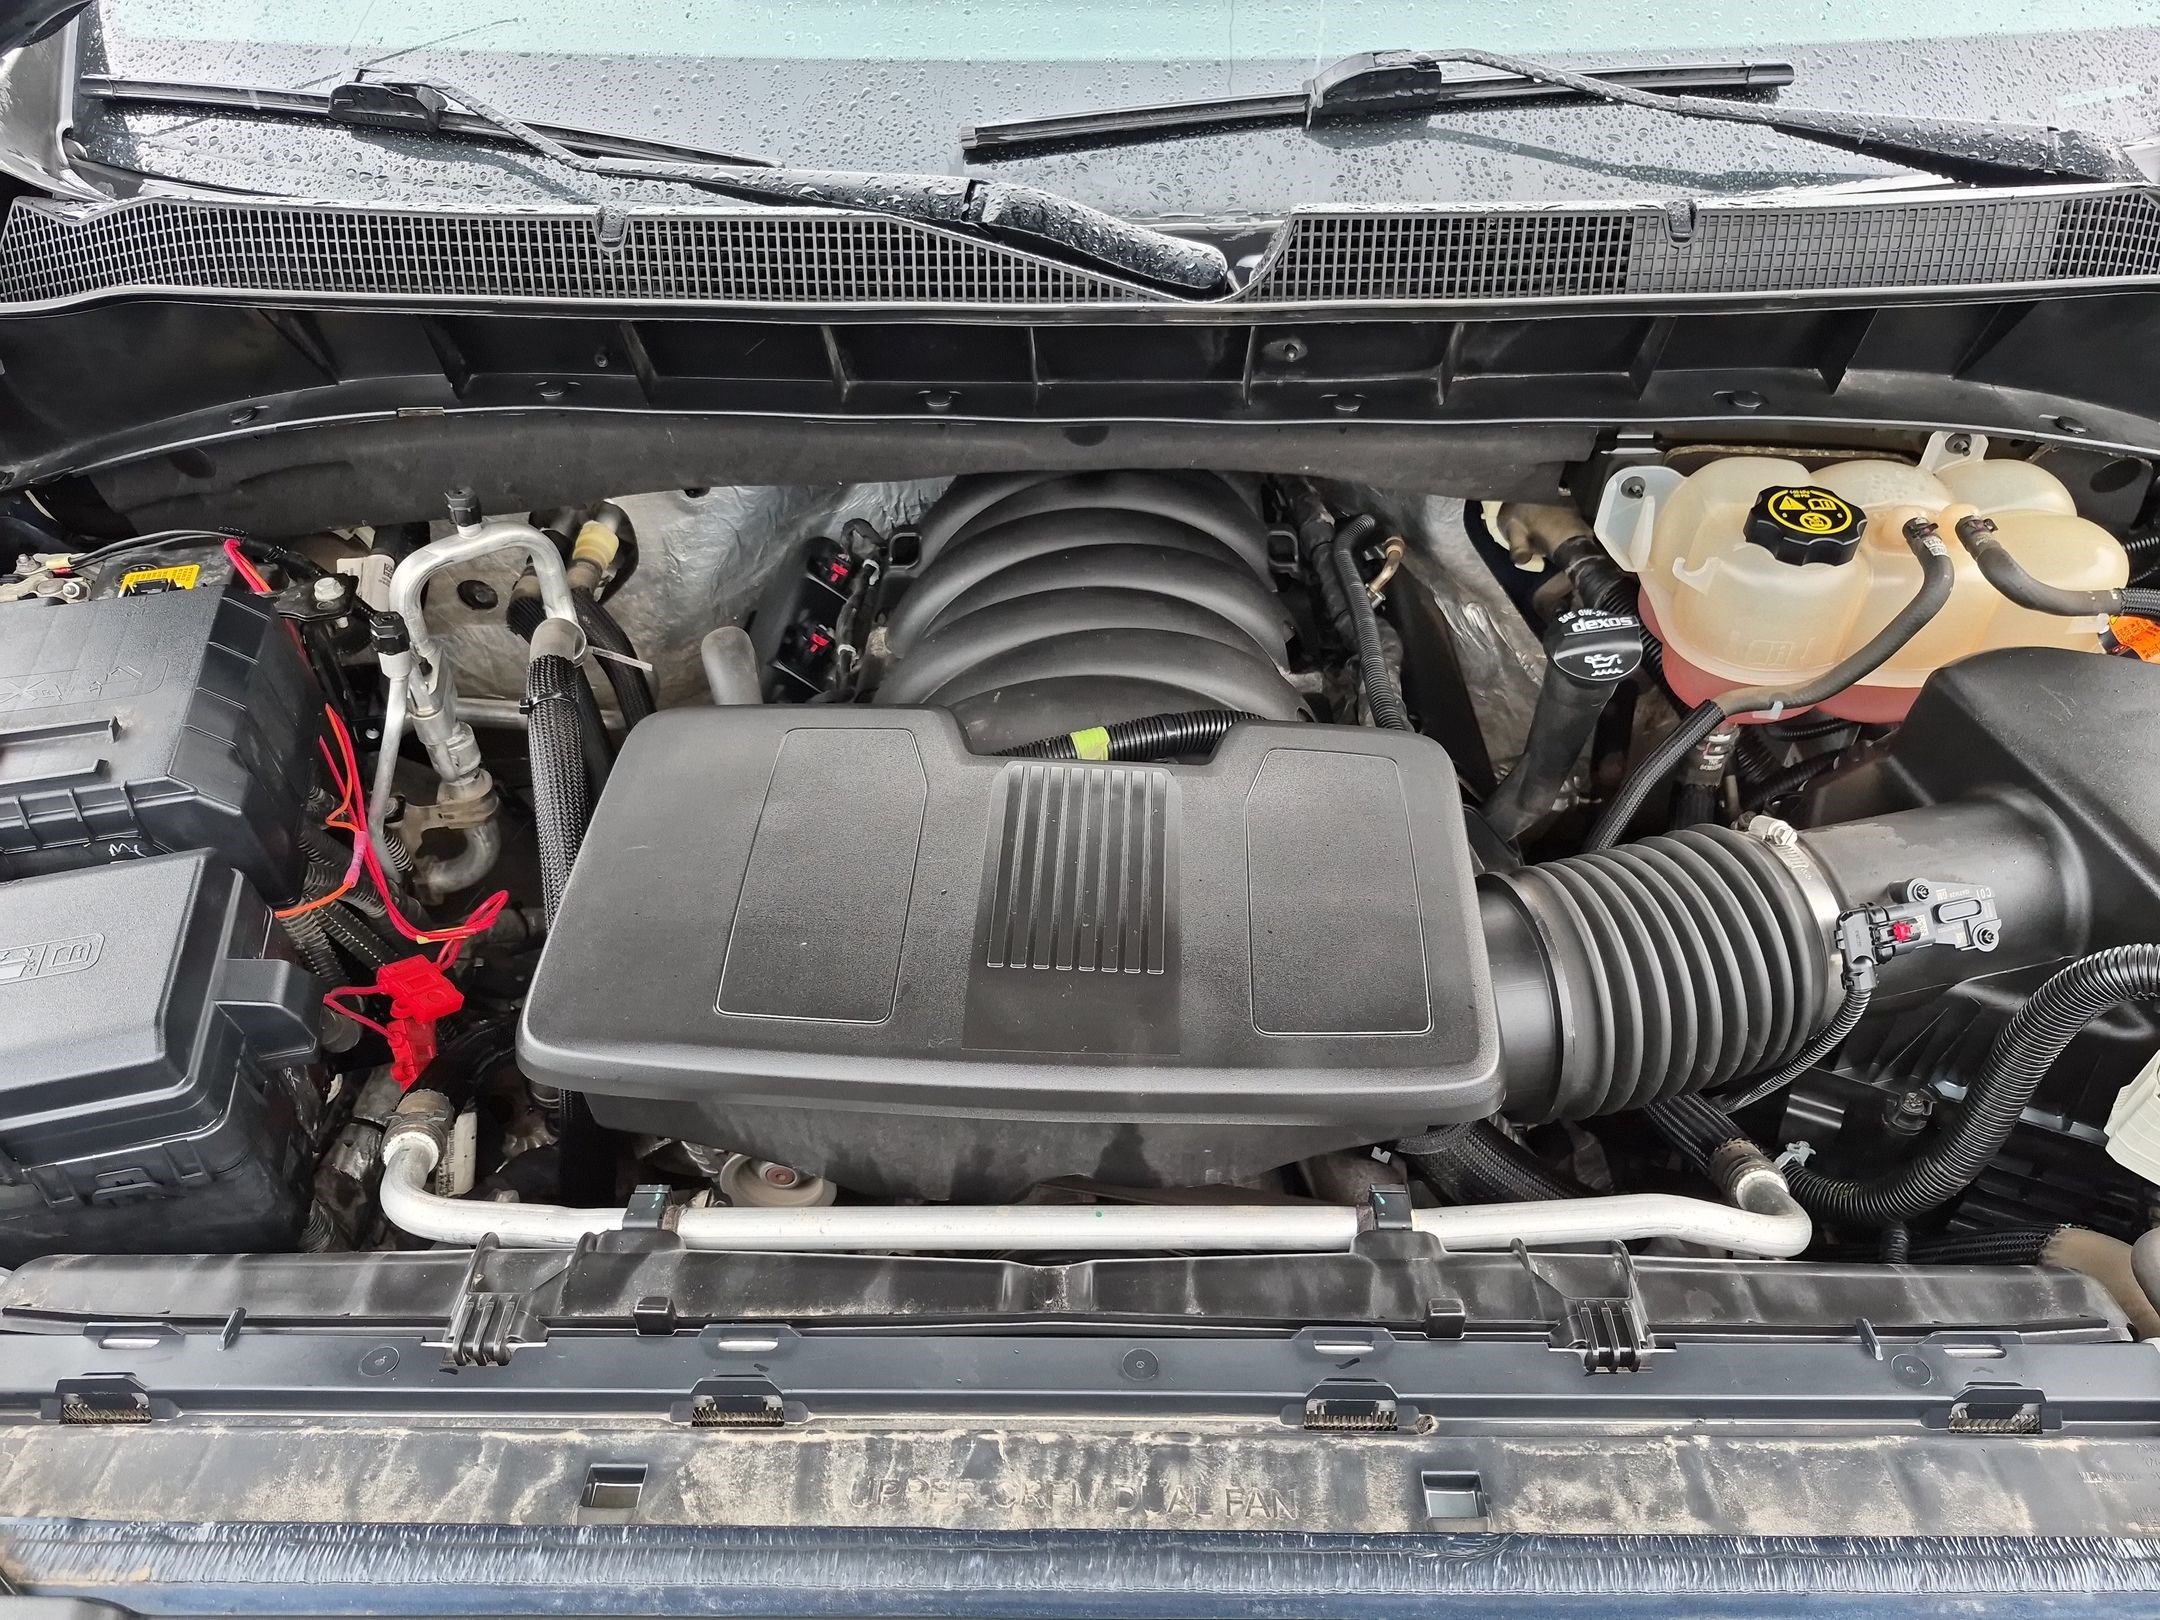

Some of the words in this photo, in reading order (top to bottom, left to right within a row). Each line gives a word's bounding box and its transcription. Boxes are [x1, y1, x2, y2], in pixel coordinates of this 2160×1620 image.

[1558, 611, 1576, 624] SAE
[1571, 617, 1633, 632] dexos
[848, 1477, 978, 1508] UPPER
[1114, 1482, 1214, 1518] DUAL
[1225, 1486, 1300, 1520] FAN
